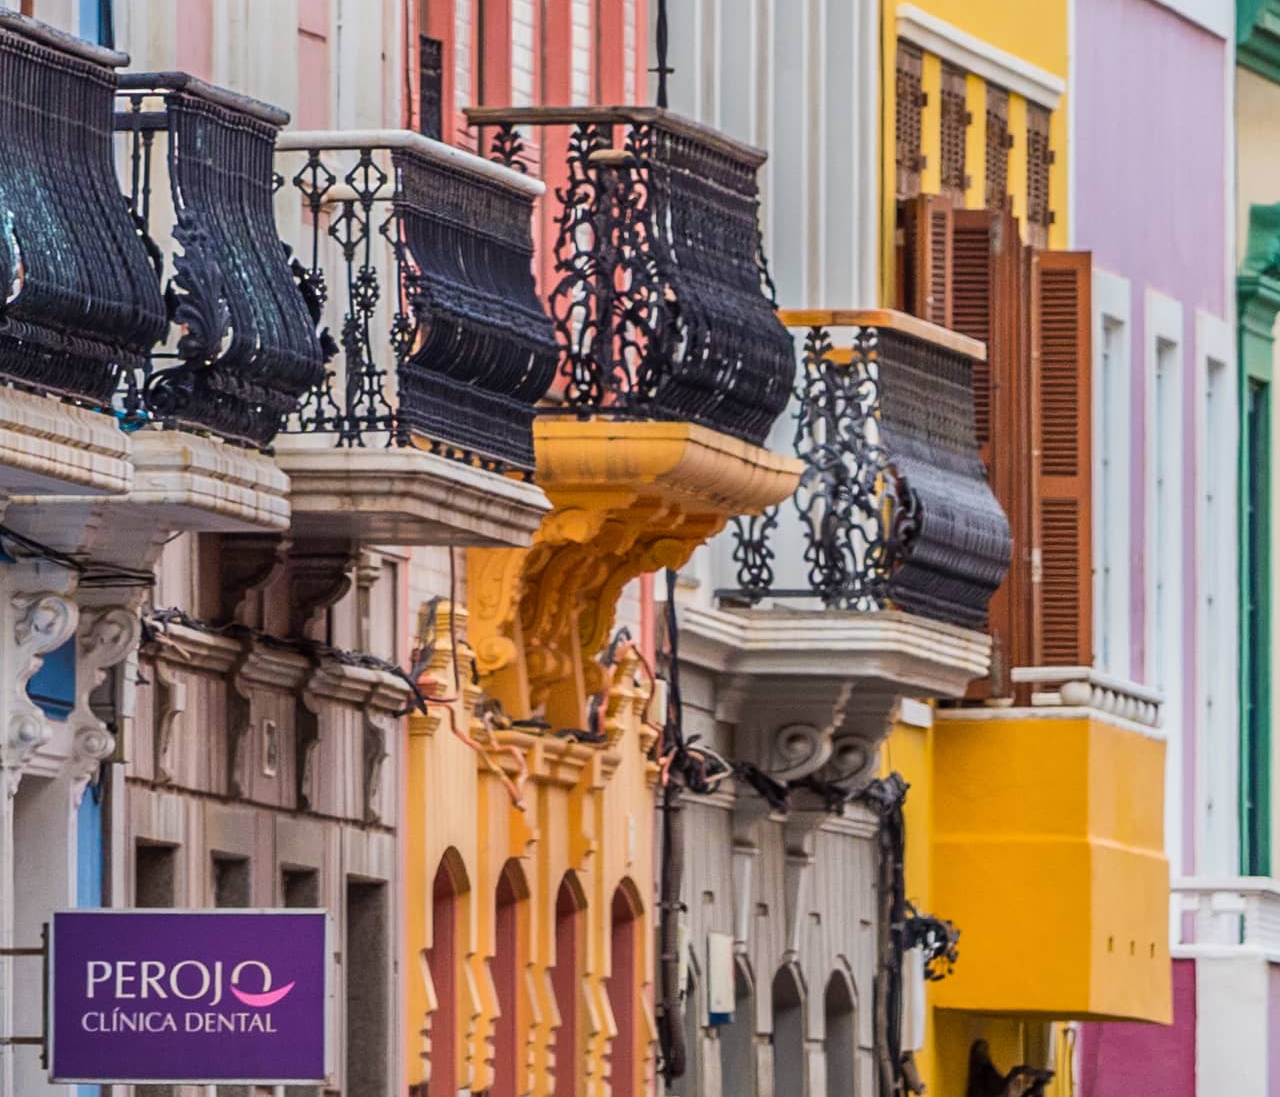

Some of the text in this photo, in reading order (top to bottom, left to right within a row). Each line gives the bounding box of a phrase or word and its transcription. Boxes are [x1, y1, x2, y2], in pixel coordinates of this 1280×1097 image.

[85, 960, 295, 1007] PEROJO
[81, 1006, 278, 1033] CLÍNICA DENTAL
